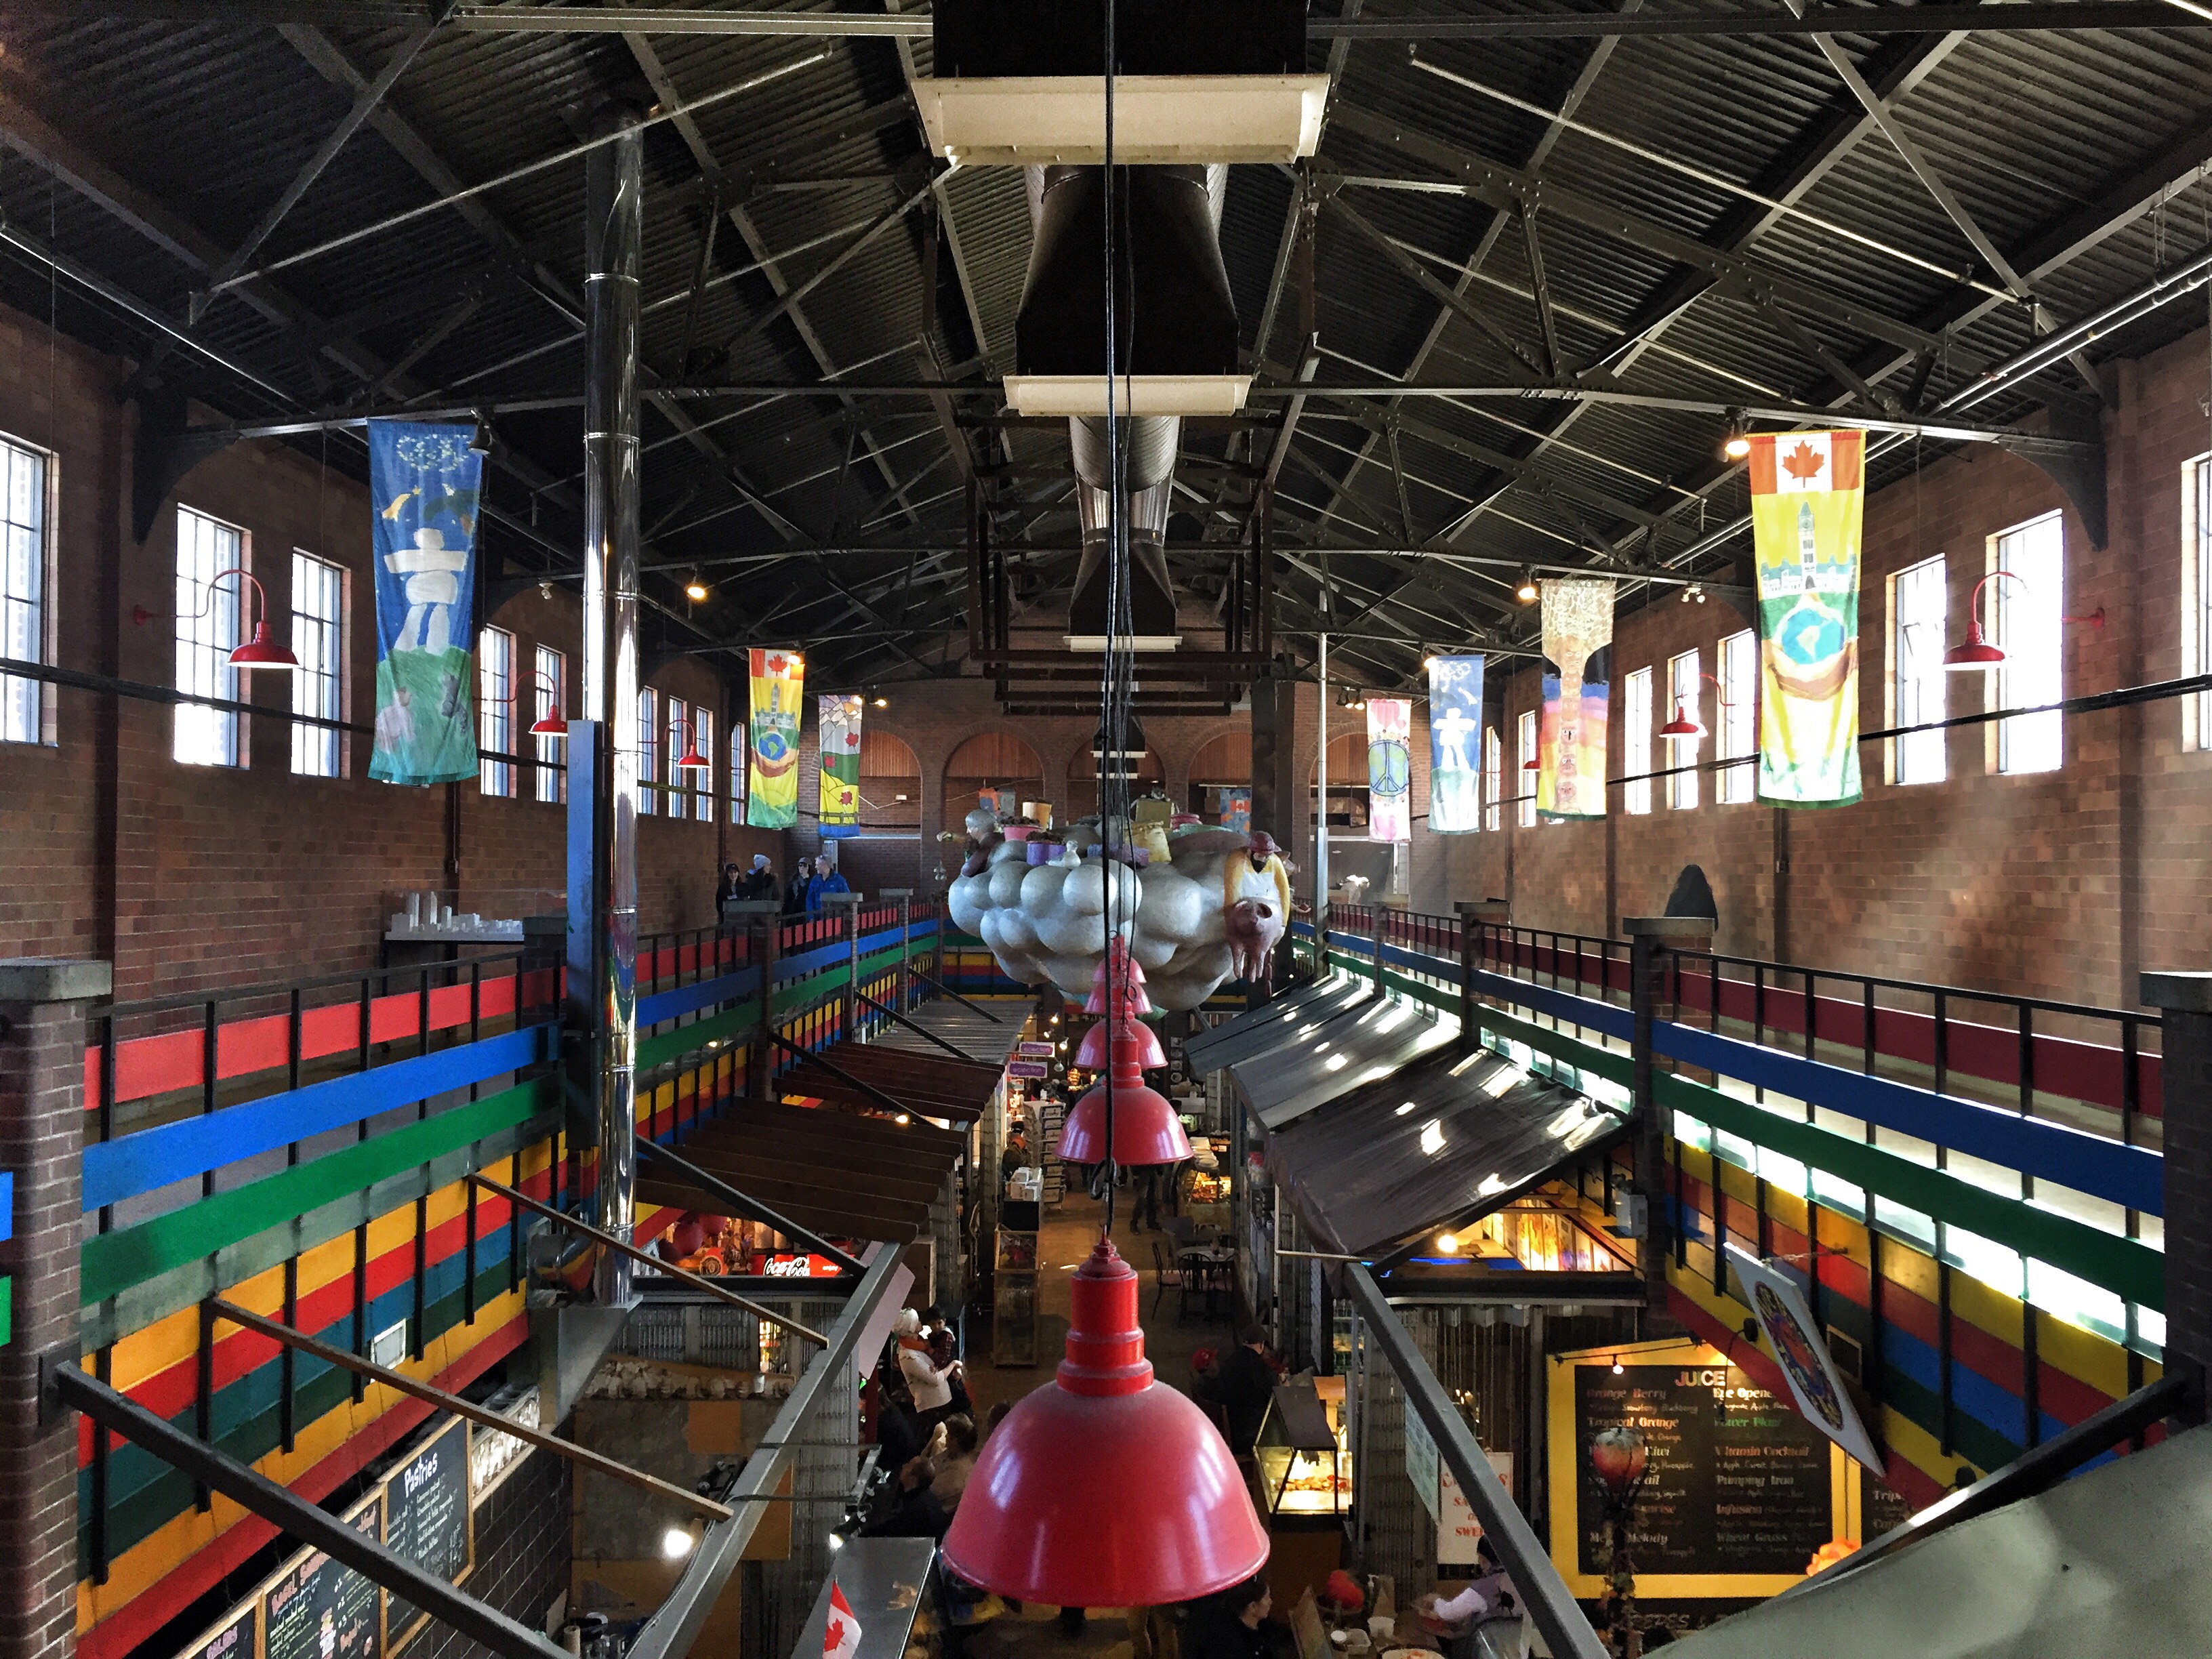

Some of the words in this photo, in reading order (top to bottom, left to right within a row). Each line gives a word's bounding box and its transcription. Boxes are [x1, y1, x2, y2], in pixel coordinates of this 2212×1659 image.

[1674, 1370, 1726, 1387] JUICE
[1586, 1388, 1626, 1400] Orange
[1633, 1388, 1666, 1400] Berry
[1737, 1387, 1777, 1401] Opene
[1639, 1416, 1679, 1429] Orange
[404, 1452, 438, 1498] Pastries
